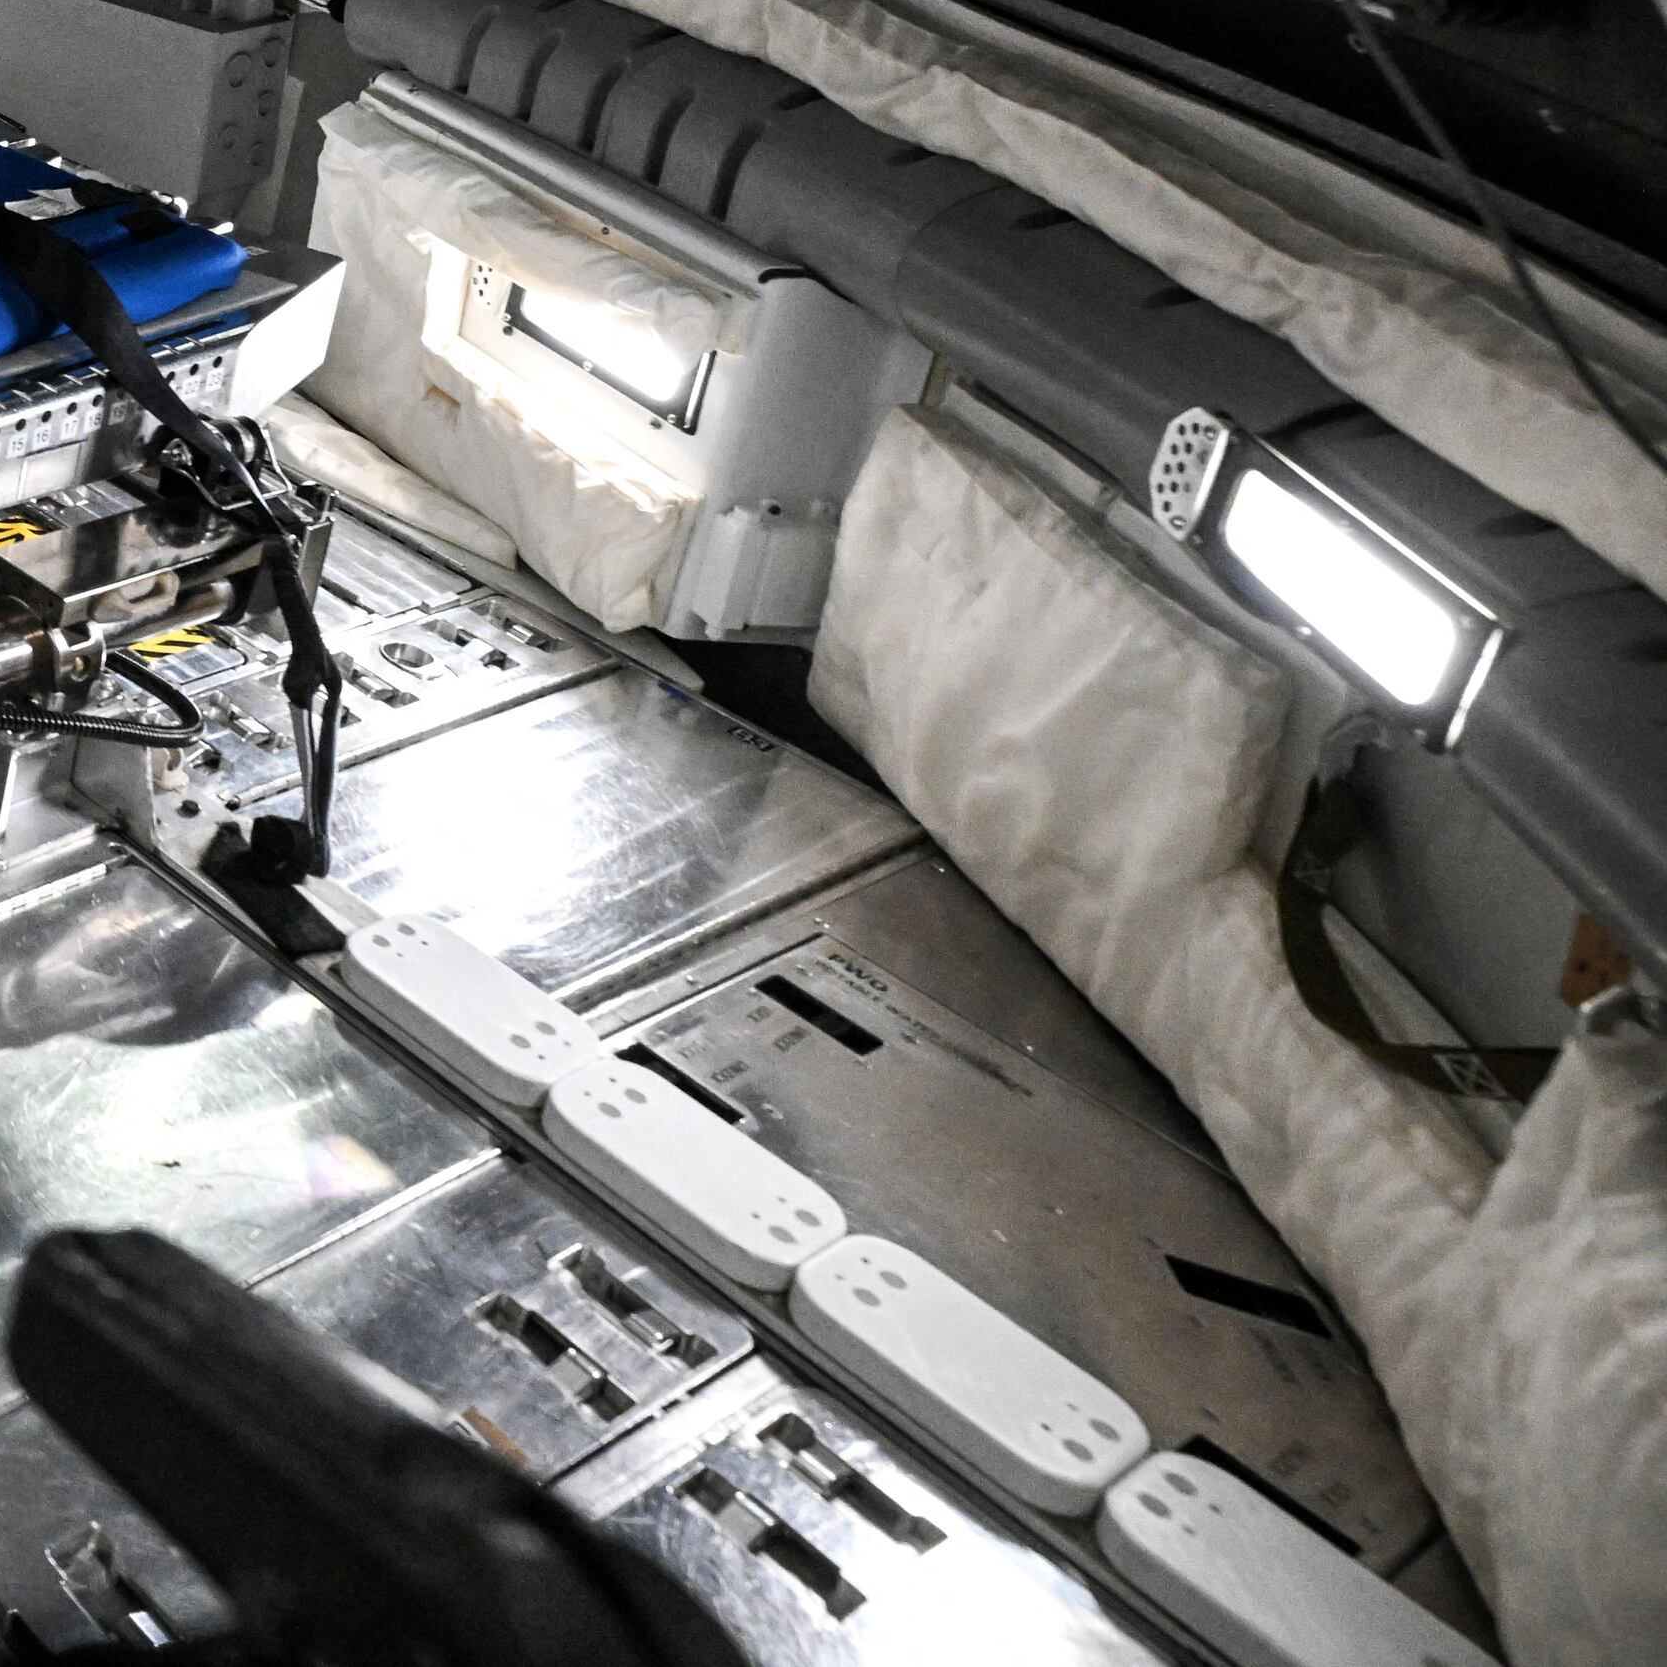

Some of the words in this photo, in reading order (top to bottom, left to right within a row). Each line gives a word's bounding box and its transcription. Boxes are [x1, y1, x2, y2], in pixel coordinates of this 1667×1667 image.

[11, 439, 24, 452] 15
[35, 429, 49, 443] 16
[64, 421, 77, 434] 17
[89, 412, 103, 427] 18
